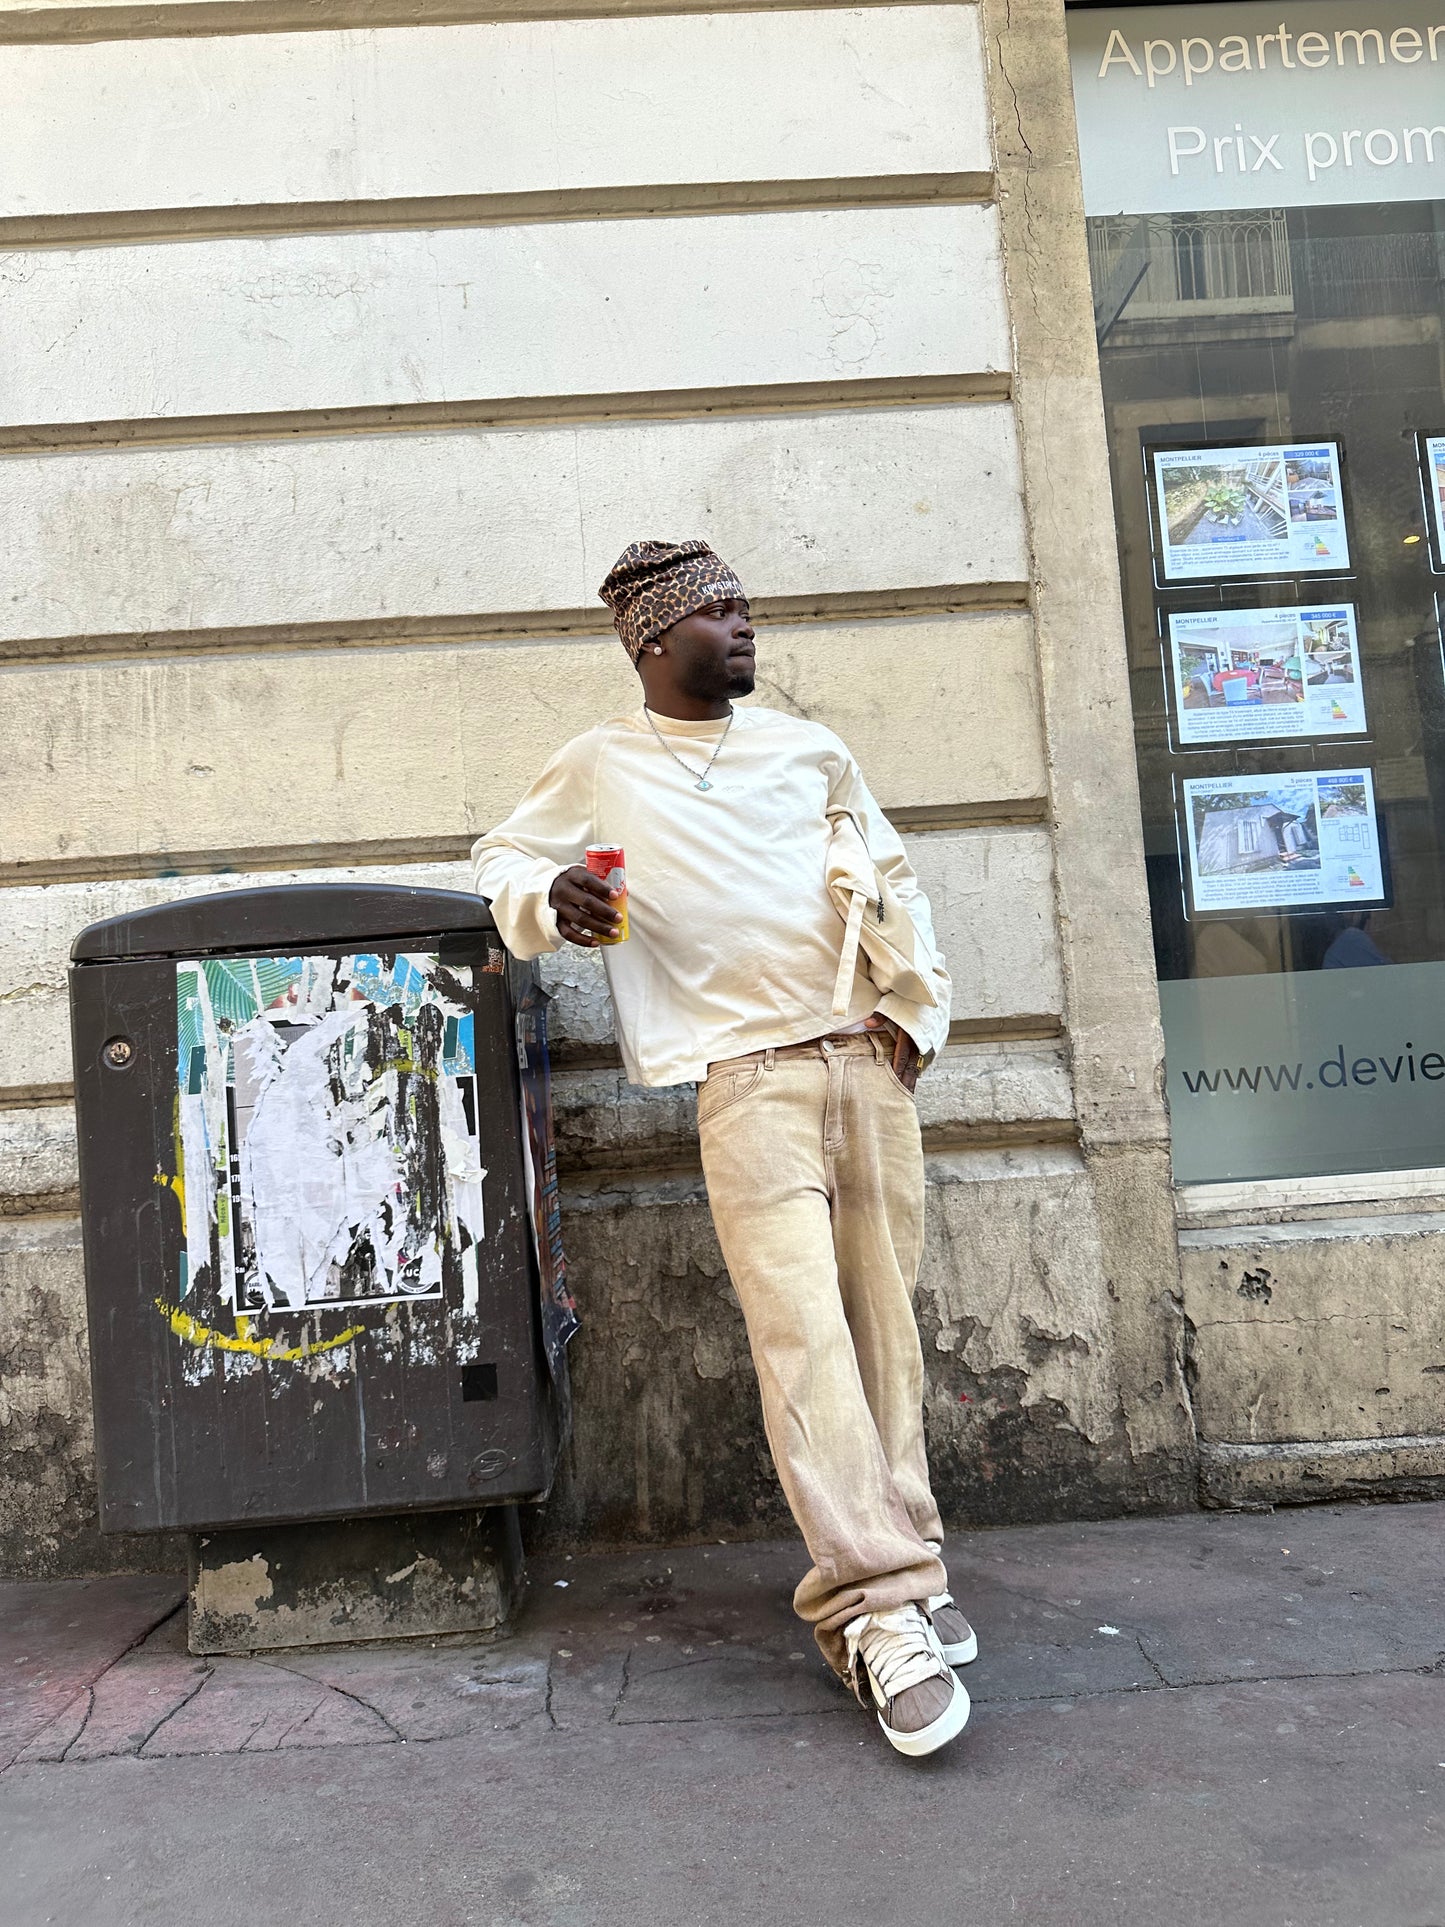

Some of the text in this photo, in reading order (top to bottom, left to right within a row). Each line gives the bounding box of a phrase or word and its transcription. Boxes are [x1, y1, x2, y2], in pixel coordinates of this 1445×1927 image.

[1167, 123, 1445, 182] Prix prom
[1189, 782, 1233, 790] MONTPELLIER
[1182, 1042, 1445, 1093] www.devie
[230, 1153, 241, 1162] 16
